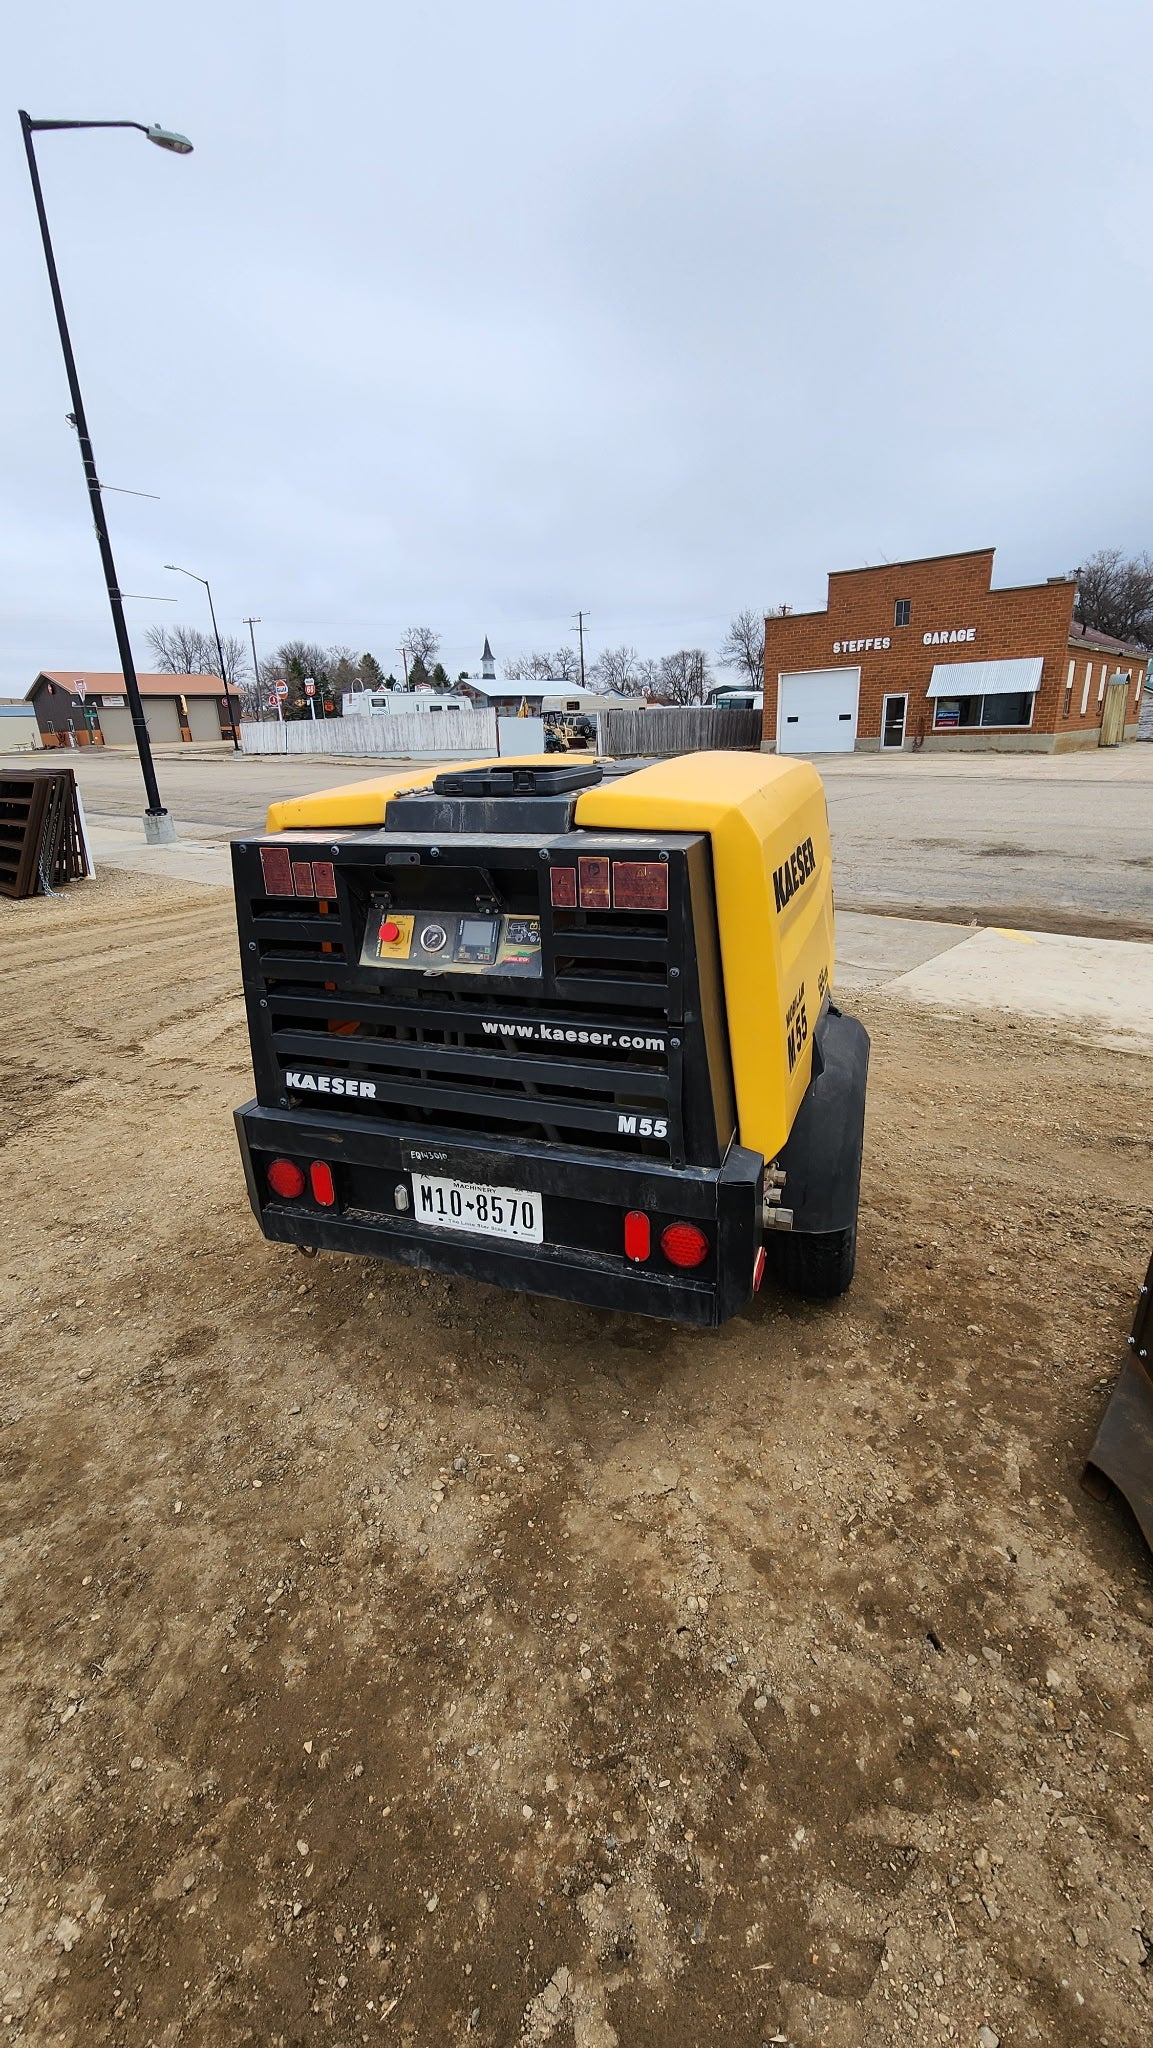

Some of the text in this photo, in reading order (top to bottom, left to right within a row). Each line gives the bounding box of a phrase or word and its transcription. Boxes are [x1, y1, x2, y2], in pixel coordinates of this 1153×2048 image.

[832, 628, 977, 654] STEFFES GARAGE
[772, 836, 816, 914] KAESER
[482, 1022, 665, 1051] www.kaeser.com
[286, 1072, 377, 1099] KAESER
[410, 1150, 448, 1160] EQ143010
[453, 1182, 497, 1194] MACHINERY
